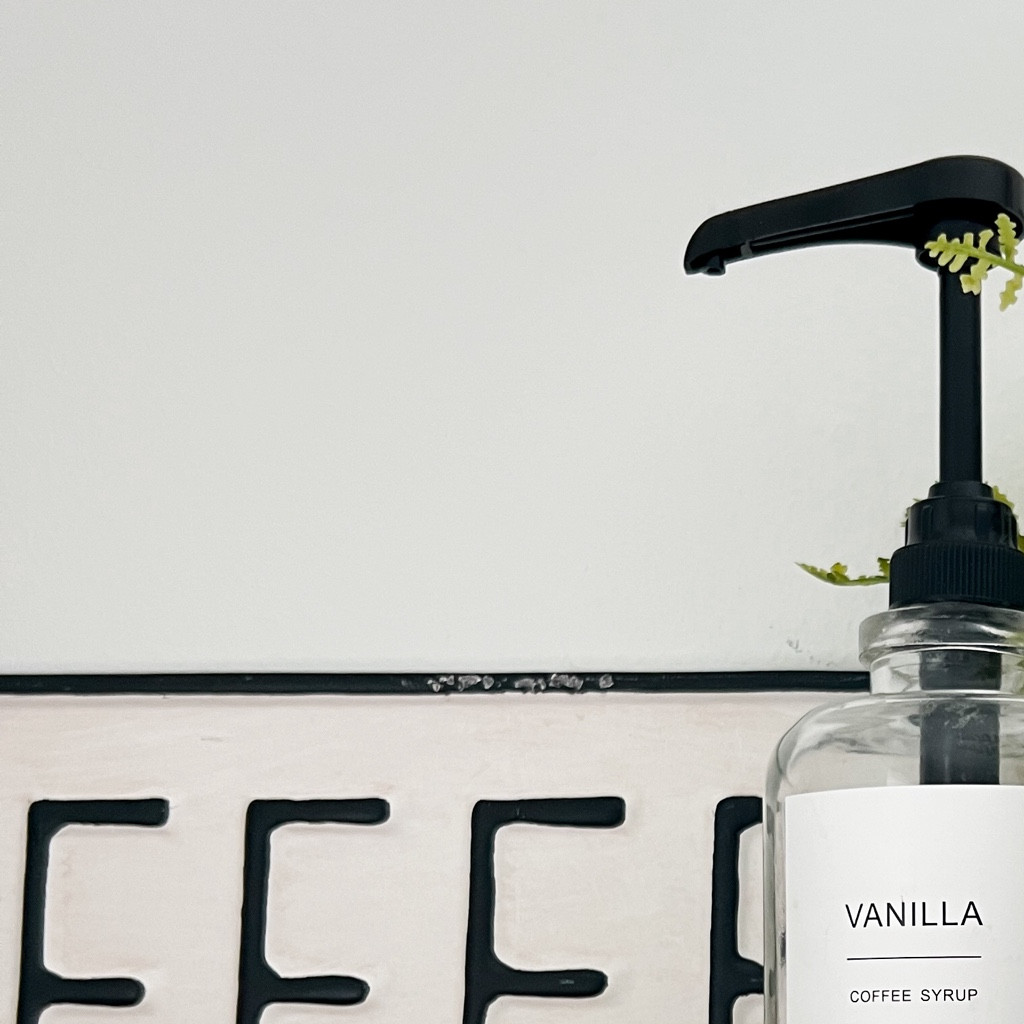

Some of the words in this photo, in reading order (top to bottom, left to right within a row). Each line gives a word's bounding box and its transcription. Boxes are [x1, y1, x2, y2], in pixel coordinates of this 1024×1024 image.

[846, 901, 983, 928] VANILLA
[850, 990, 911, 1003] COFFEE
[921, 989, 977, 1001] SYRUP
